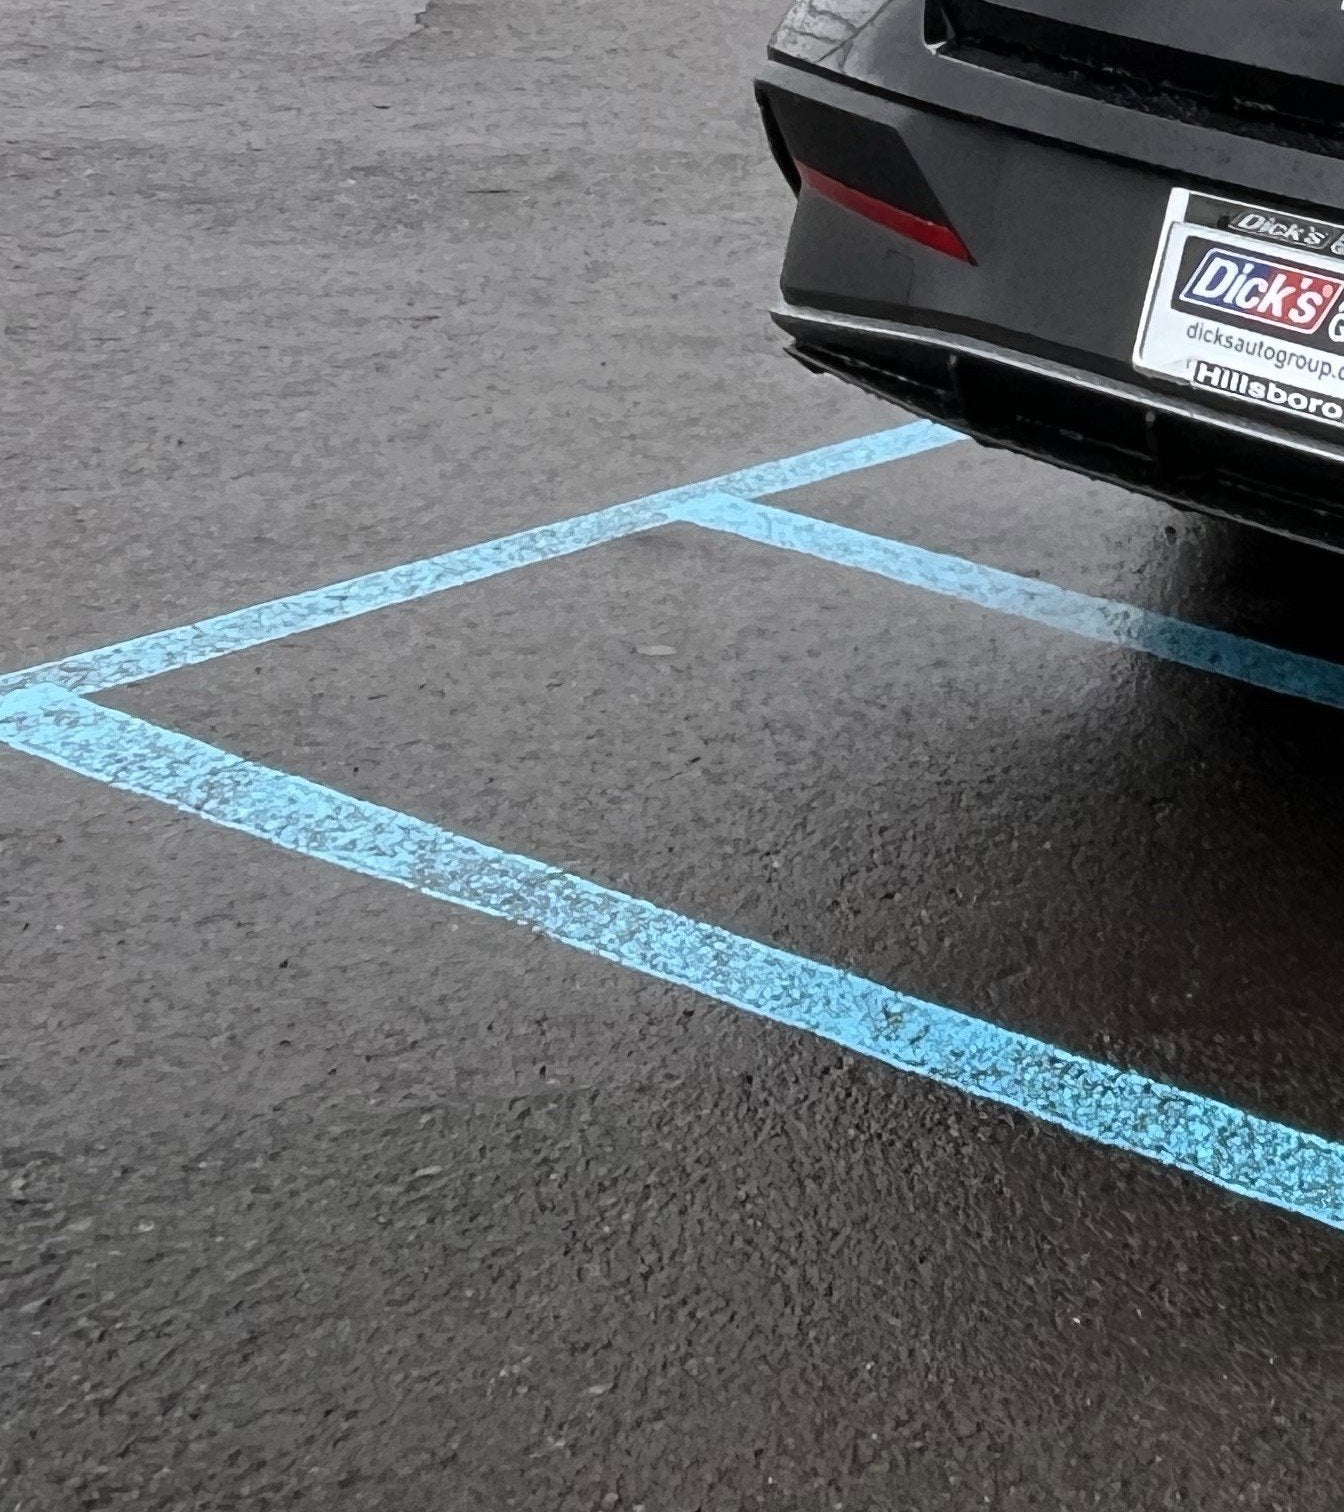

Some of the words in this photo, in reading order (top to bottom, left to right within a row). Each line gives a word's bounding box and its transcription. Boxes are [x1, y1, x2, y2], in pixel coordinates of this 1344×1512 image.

[1236, 213, 1326, 245] Dick's
[1192, 256, 1325, 327] Dick's
[1196, 360, 1344, 420] Hillsboro
